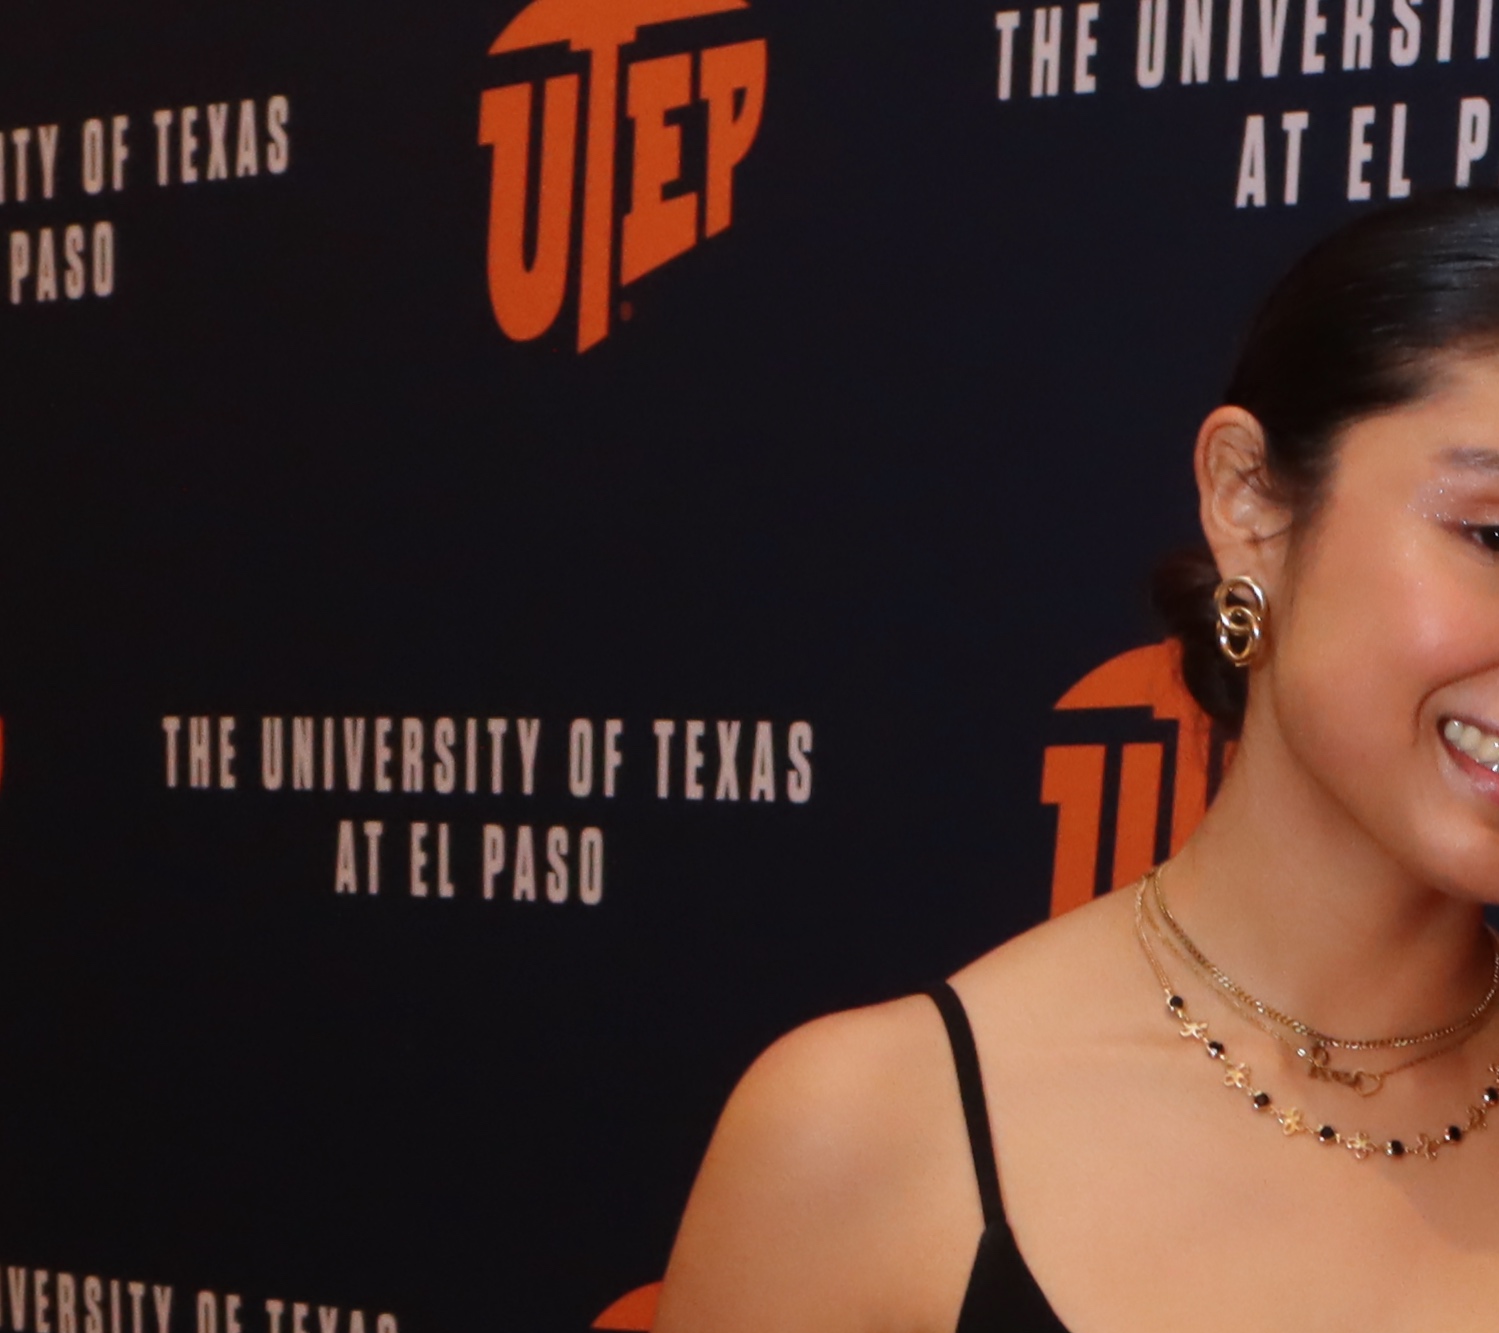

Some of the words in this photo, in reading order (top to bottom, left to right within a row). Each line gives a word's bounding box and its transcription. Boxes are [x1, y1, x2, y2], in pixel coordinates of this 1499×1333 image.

[995, 3, 1100, 101] THE
[82, 114, 129, 195] OF
[153, 95, 290, 187] TEXAS
[477, 0, 768, 354] UTEP
[1235, 111, 1309, 208] AT
[1347, 103, 1412, 201] EL
[9, 221, 114, 305] PASO
[162, 716, 236, 789] THE
[261, 716, 541, 796] UNIVERSITY
[569, 718, 624, 799] OF
[653, 719, 815, 804] TEXAS
[335, 820, 384, 895] AT
[410, 821, 454, 898] EL
[482, 823, 604, 906] PASO
